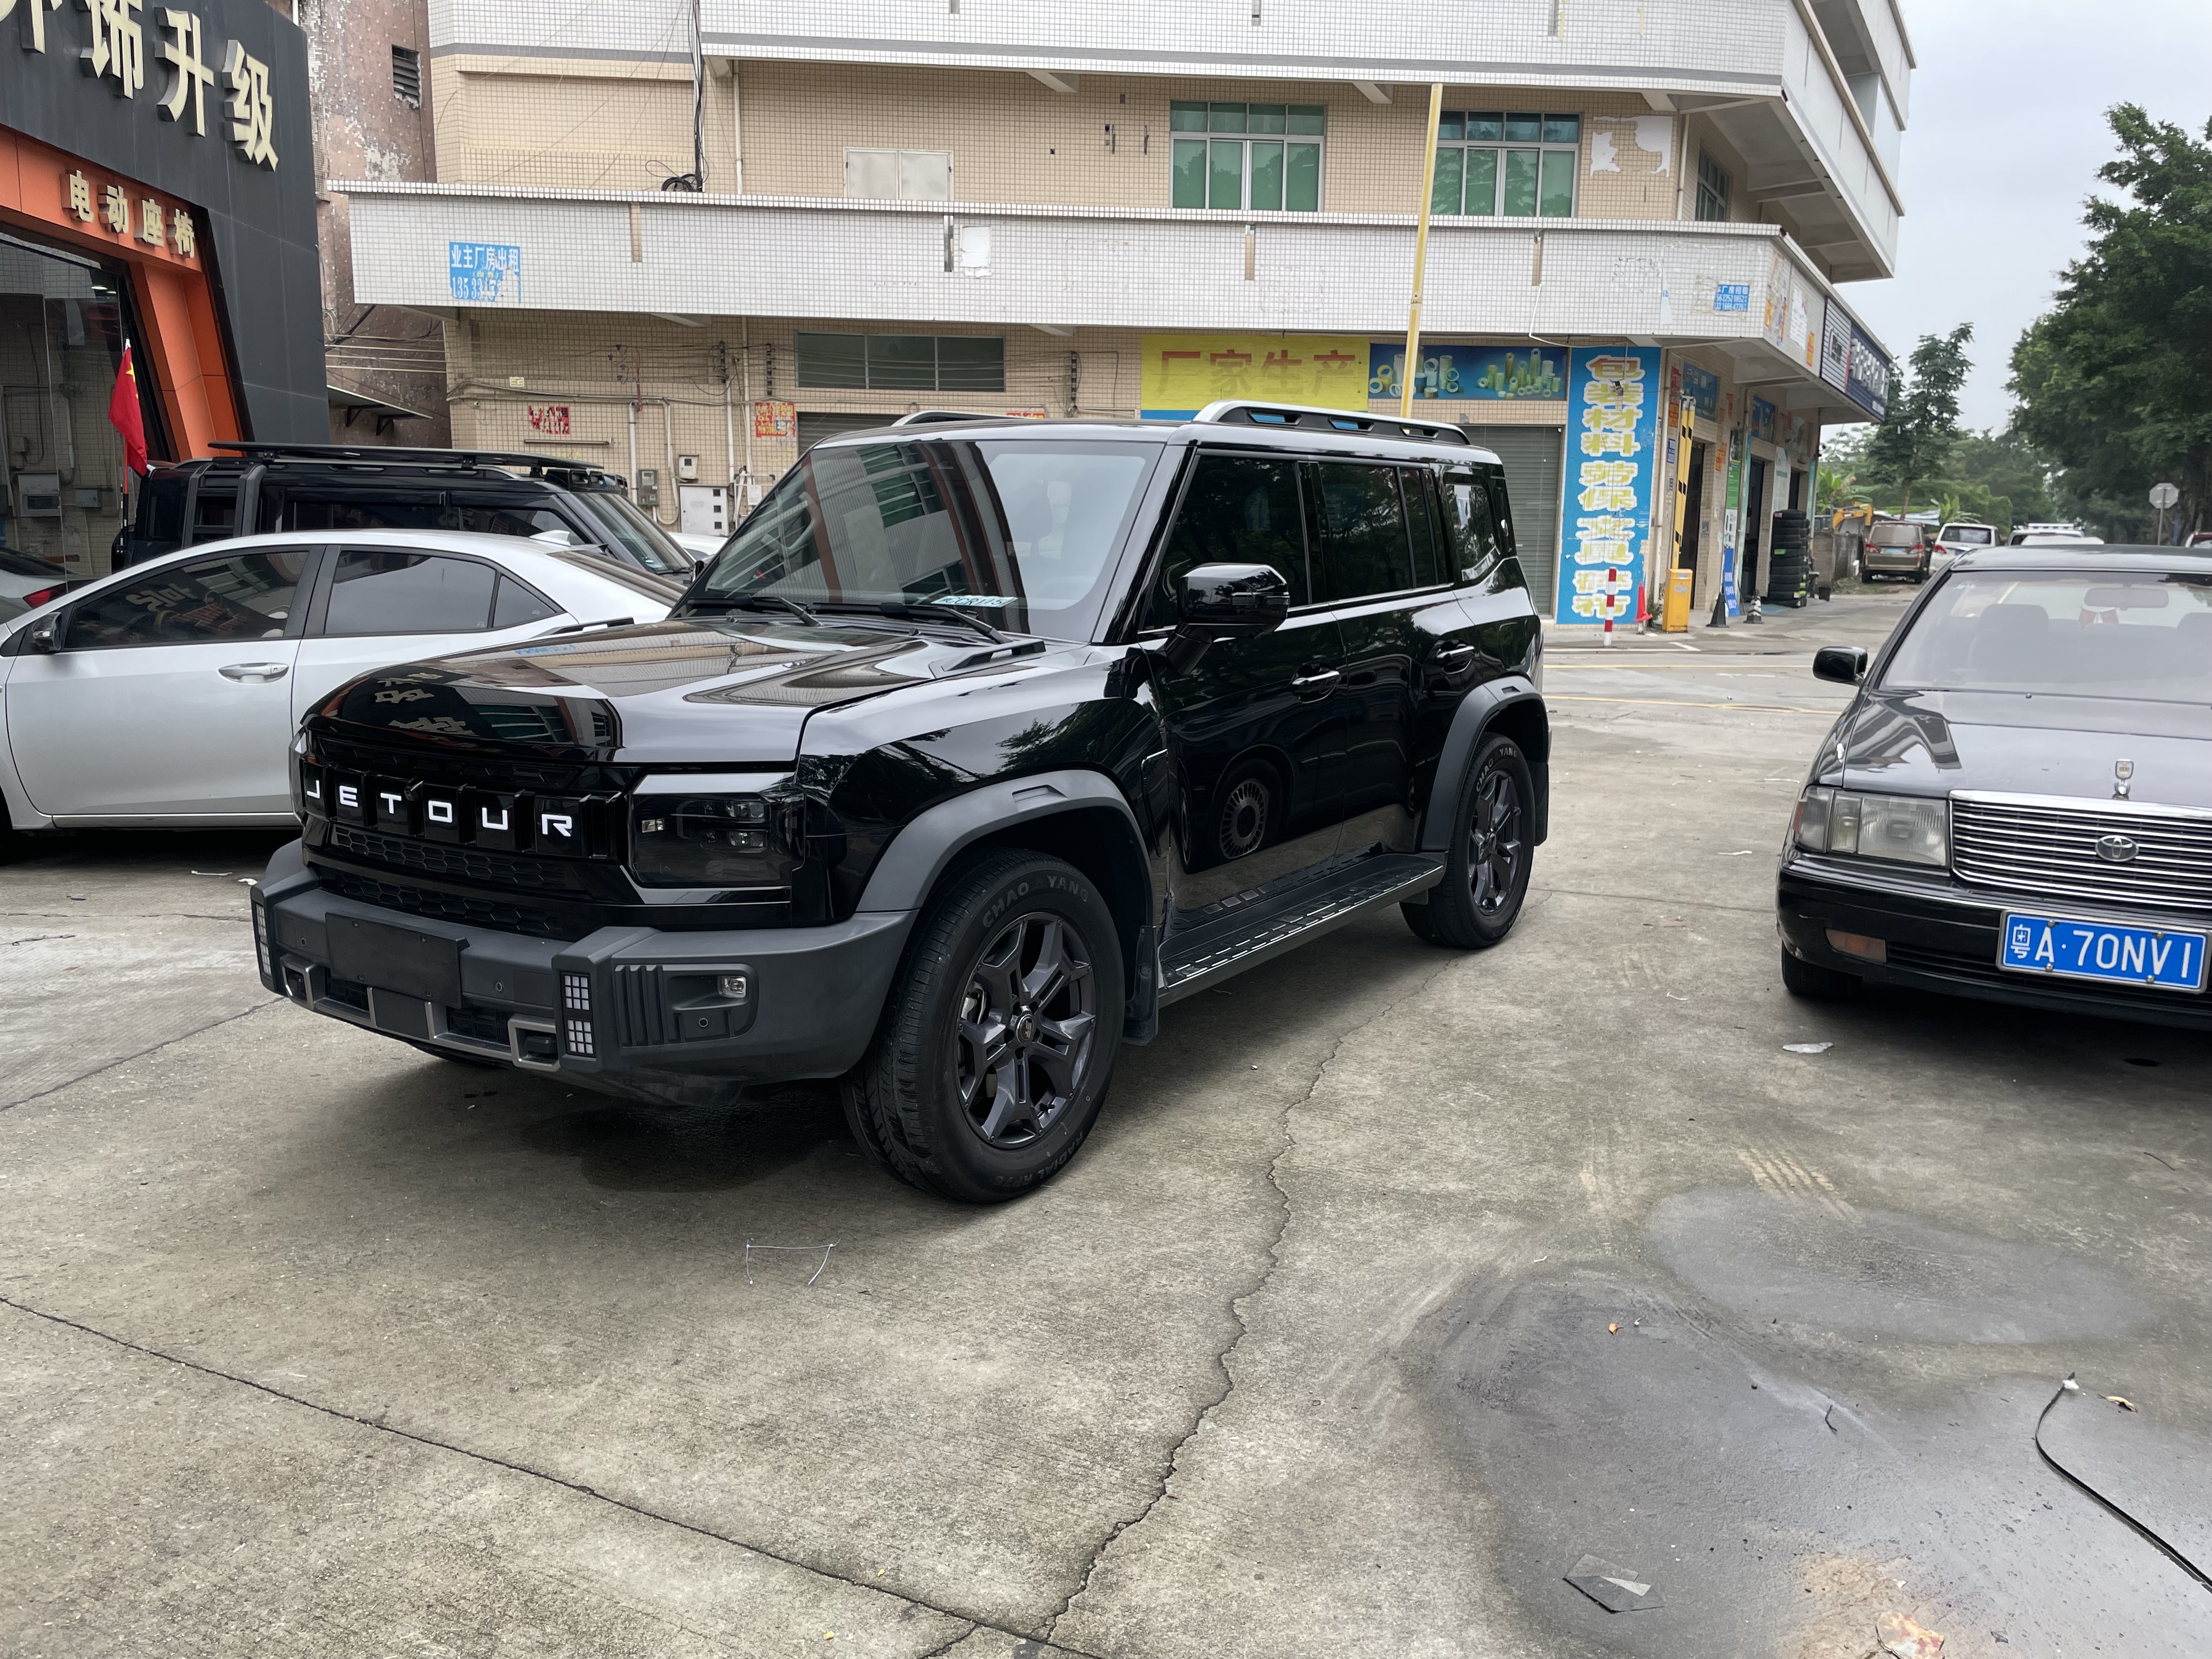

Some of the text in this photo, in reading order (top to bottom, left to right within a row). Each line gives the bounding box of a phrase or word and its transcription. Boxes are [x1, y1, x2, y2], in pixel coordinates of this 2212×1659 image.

[67, 170, 195, 259] 电动座椅
[451, 244, 520, 273] 业主厂房出租
[452, 276, 469, 300] 135
[1159, 348, 1357, 394] 厂家生产
[306, 780, 572, 837] JETOUR
[983, 875, 1089, 928] CHAO YANG
